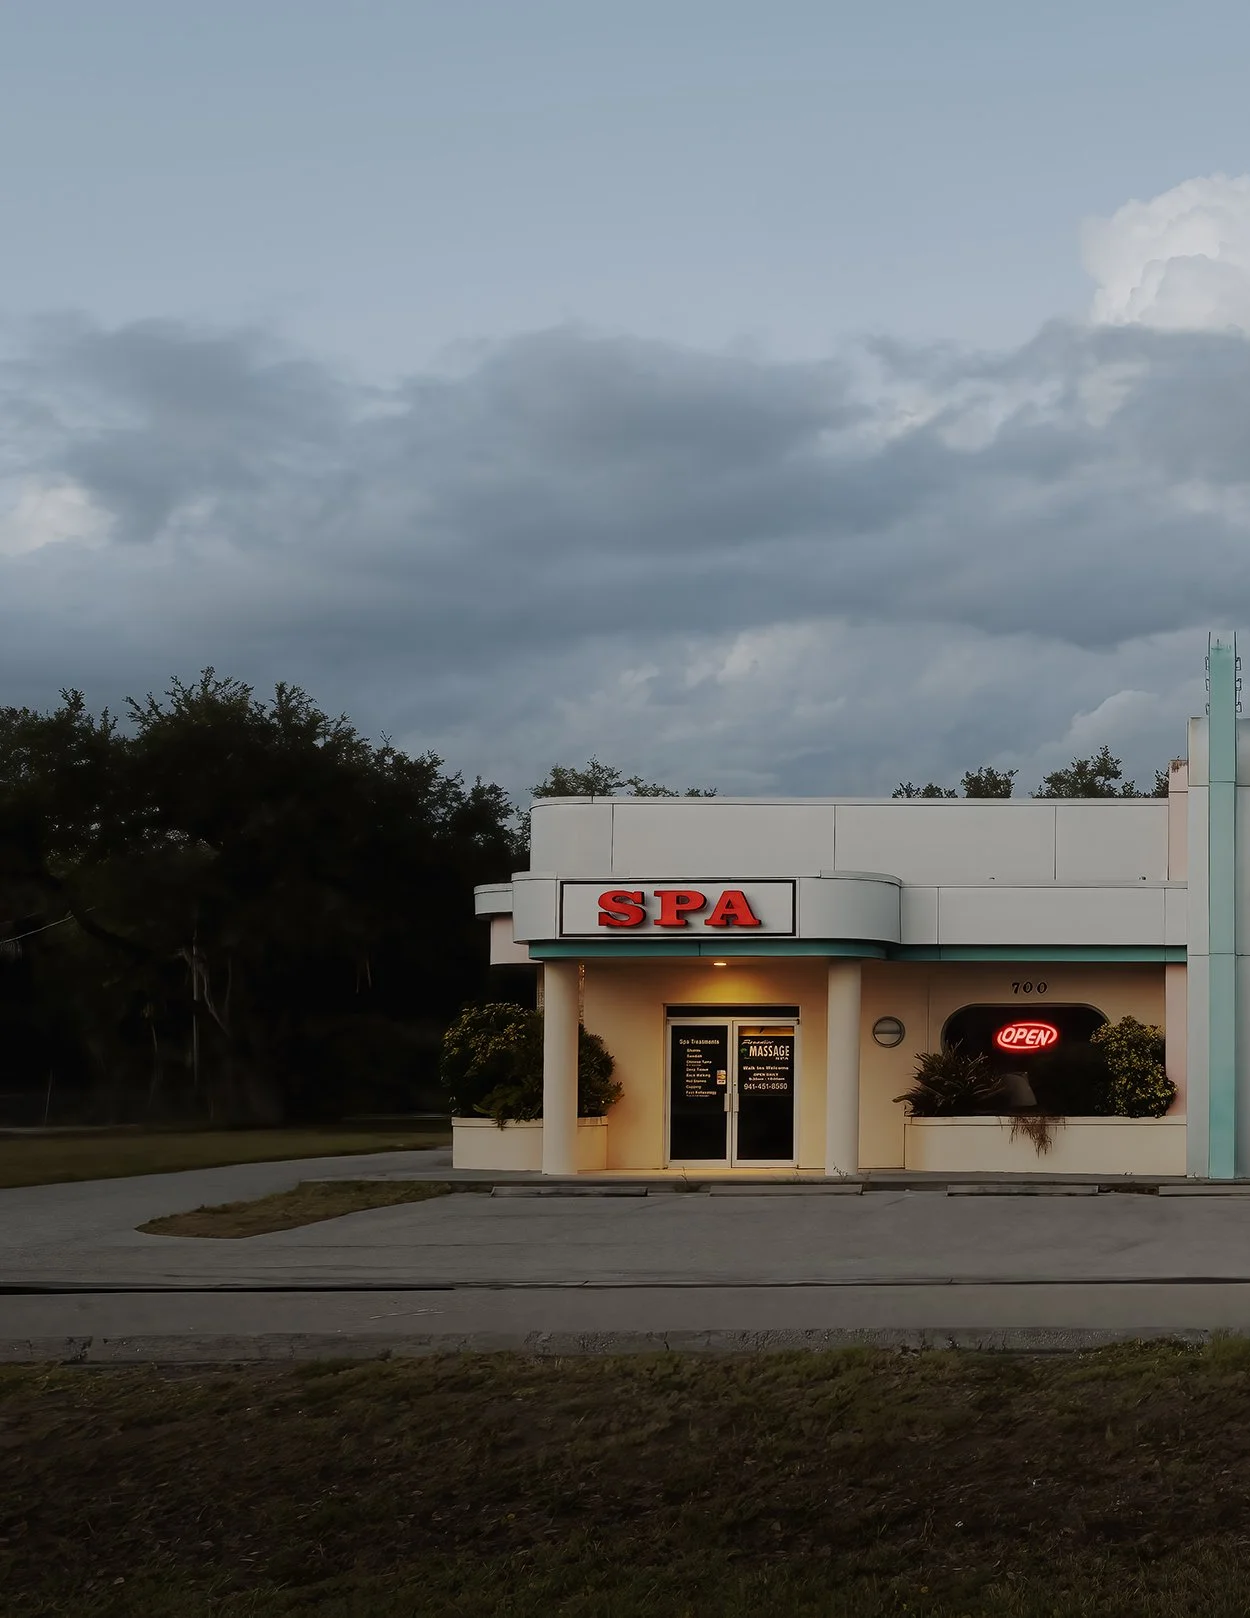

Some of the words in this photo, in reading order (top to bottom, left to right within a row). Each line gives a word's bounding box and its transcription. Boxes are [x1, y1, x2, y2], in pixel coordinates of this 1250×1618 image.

[598, 890, 762, 927] SPA
[1012, 982, 1047, 994] 700
[1002, 1027, 1051, 1046] OPEN
[749, 1045, 790, 1057] MASSAGE
